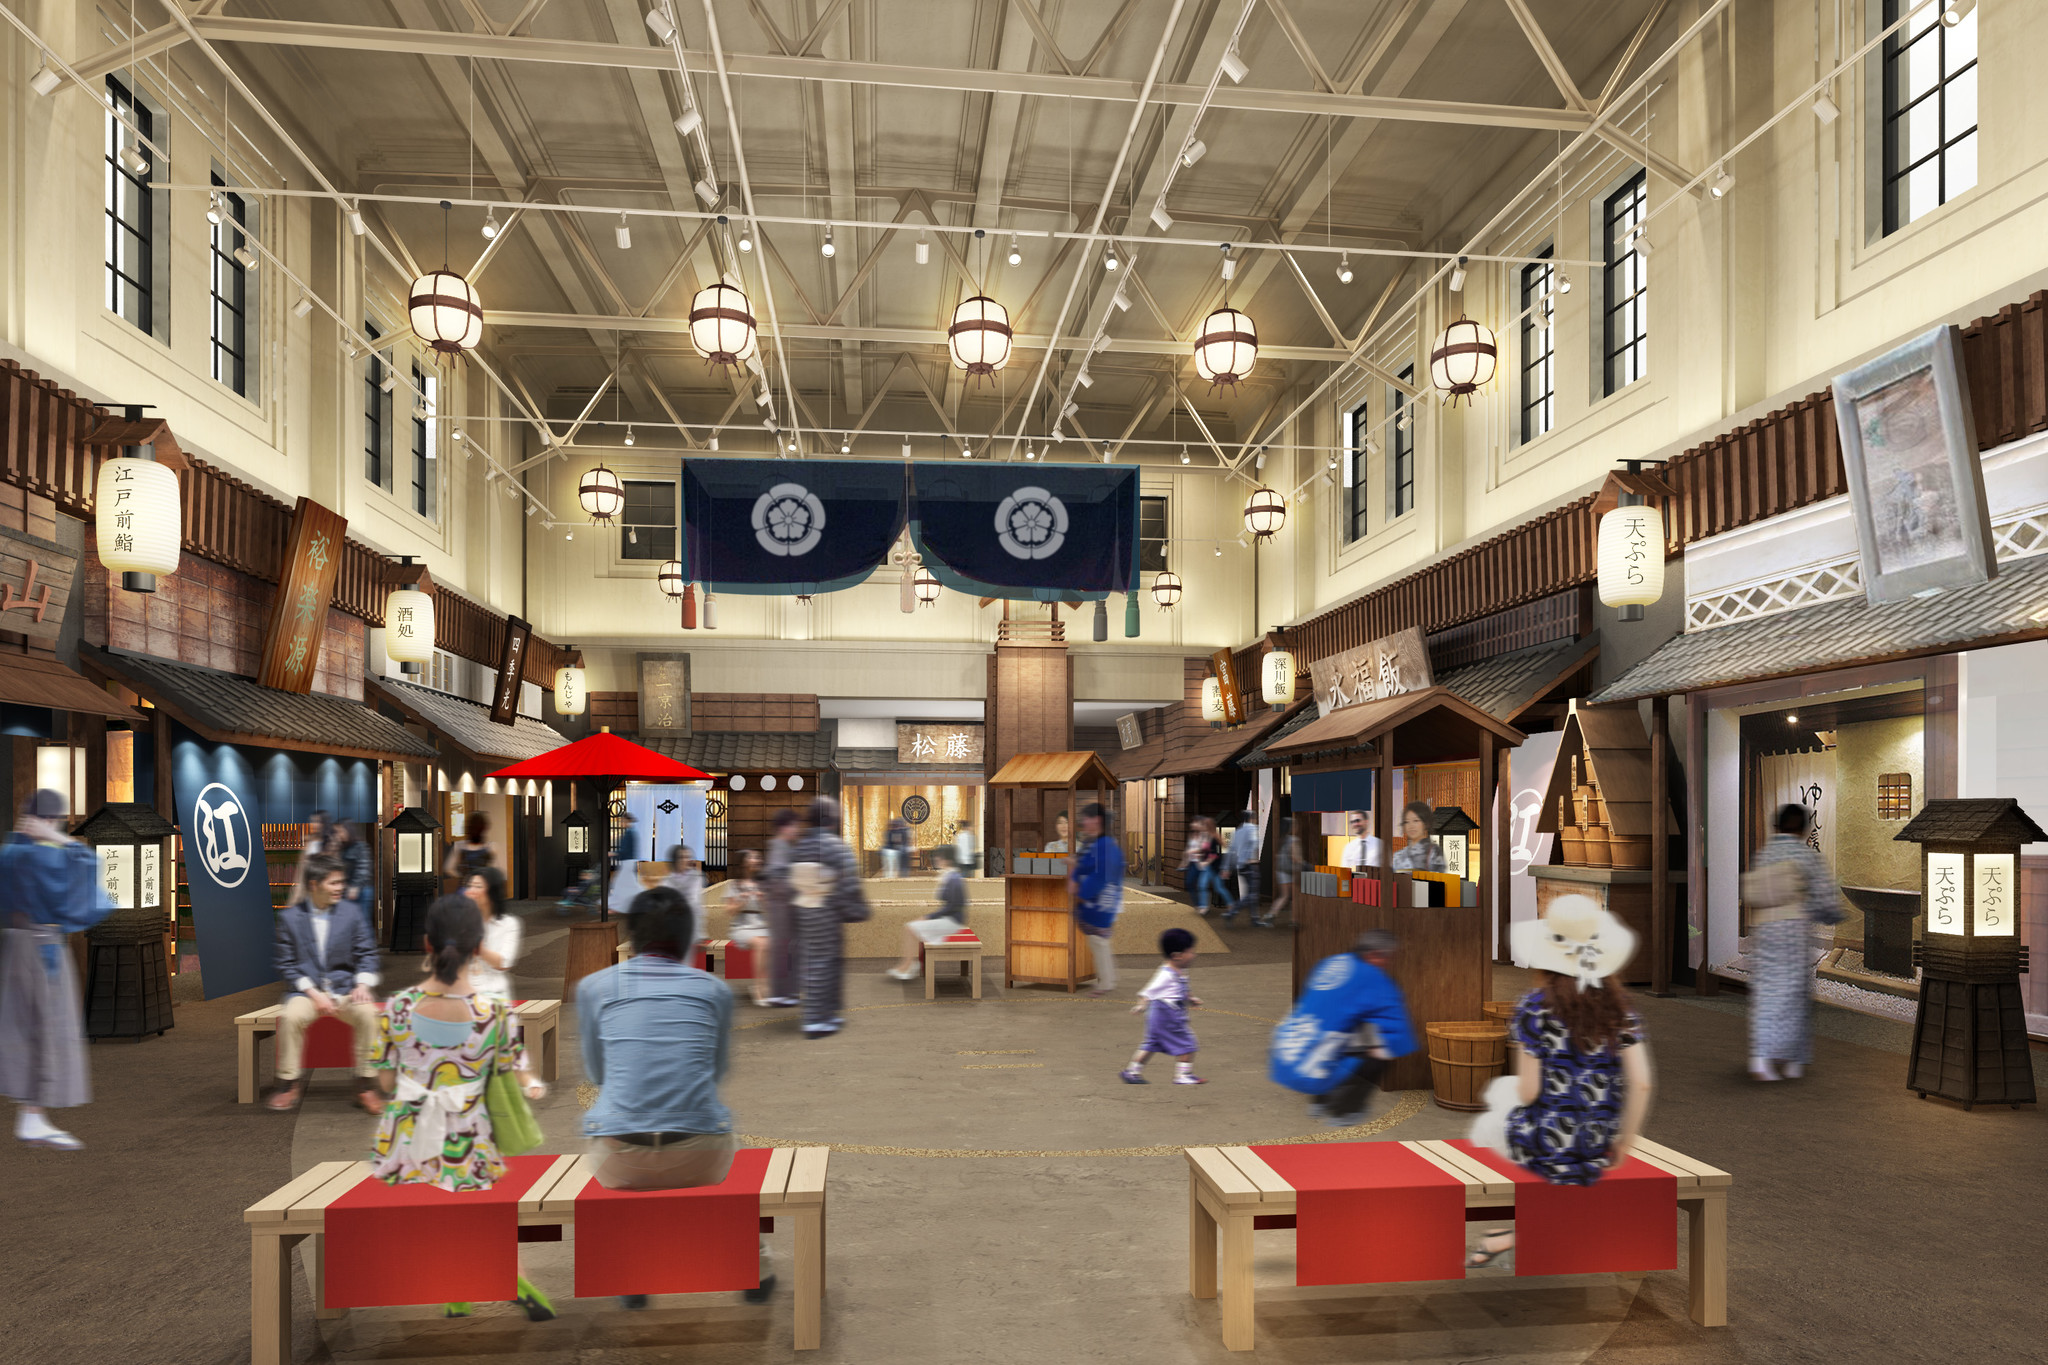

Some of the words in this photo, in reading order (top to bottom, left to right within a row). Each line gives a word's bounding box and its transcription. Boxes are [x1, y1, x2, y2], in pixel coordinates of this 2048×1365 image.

[114, 466, 134, 553] 江戸前鮨
[1624, 517, 1647, 585] 天ぷら
[0, 559, 52, 623] 山
[397, 606, 413, 638] 酒処
[564, 671, 573, 709] もんじゃ
[1274, 657, 1287, 696] 深川飯
[911, 732, 971, 759] 松藤
[106, 848, 120, 905] 江戸前鮨
[144, 848, 155, 905] 江戸前鮨
[1449, 839, 1460, 872] 深川飯
[1935, 866, 1955, 925] 天ぷら
[1982, 866, 2002, 927] 天ぷら
